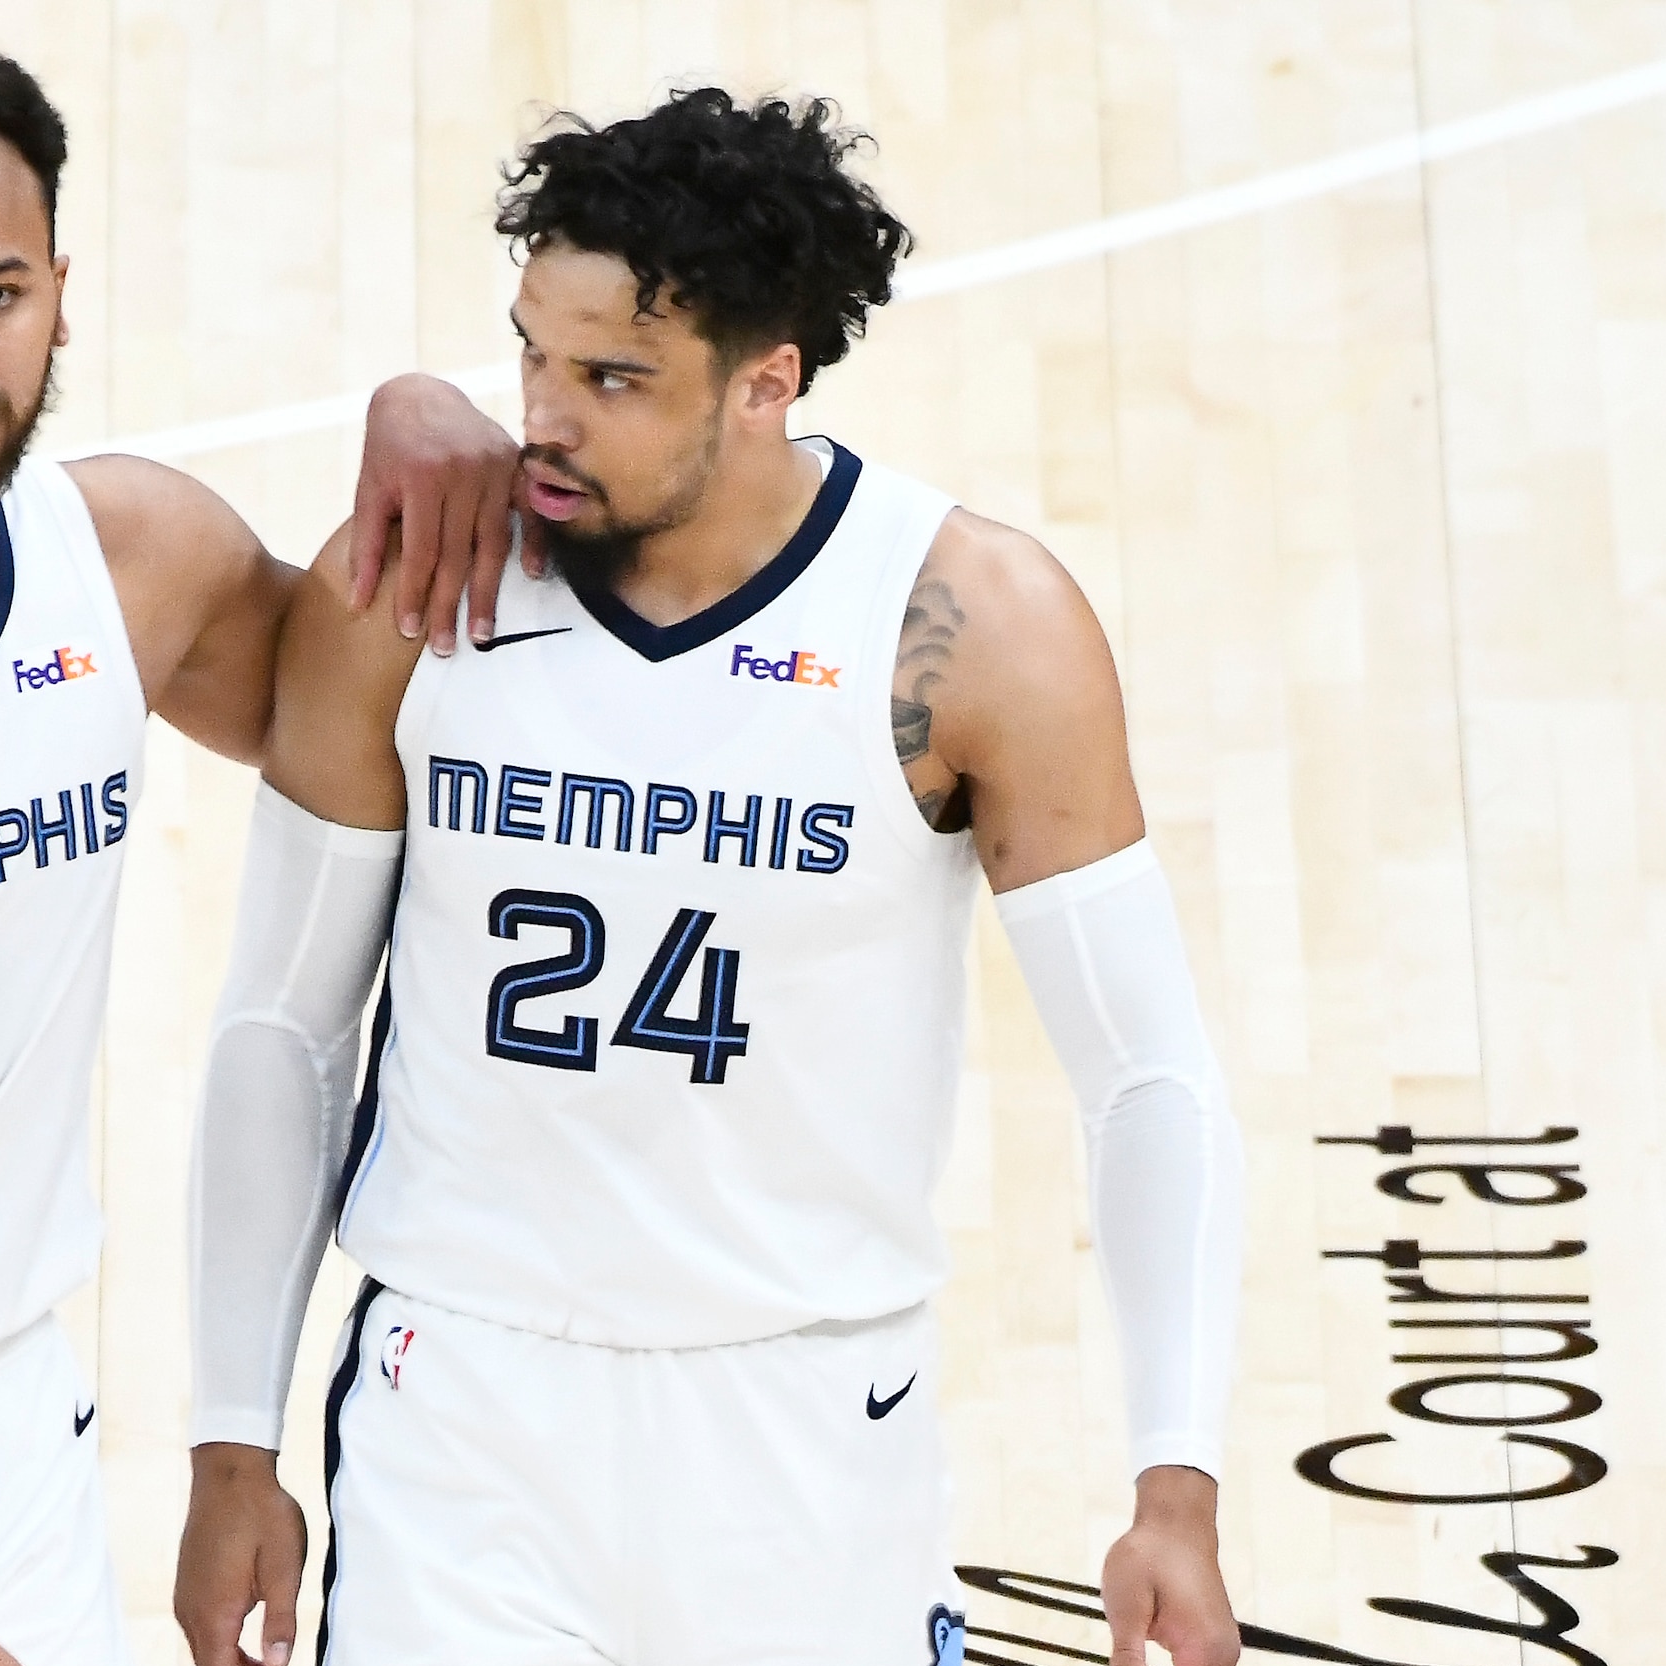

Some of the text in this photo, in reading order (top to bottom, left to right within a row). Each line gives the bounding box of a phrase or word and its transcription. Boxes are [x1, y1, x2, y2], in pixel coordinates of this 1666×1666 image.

[12, 647, 99, 693] FedEx
[730, 644, 843, 689] FedEx
[428, 754, 855, 875] MEMPHIS
[485, 888, 751, 1085] 24
[1317, 1126, 1587, 1206] at
[1295, 1239, 1608, 1505] Court
